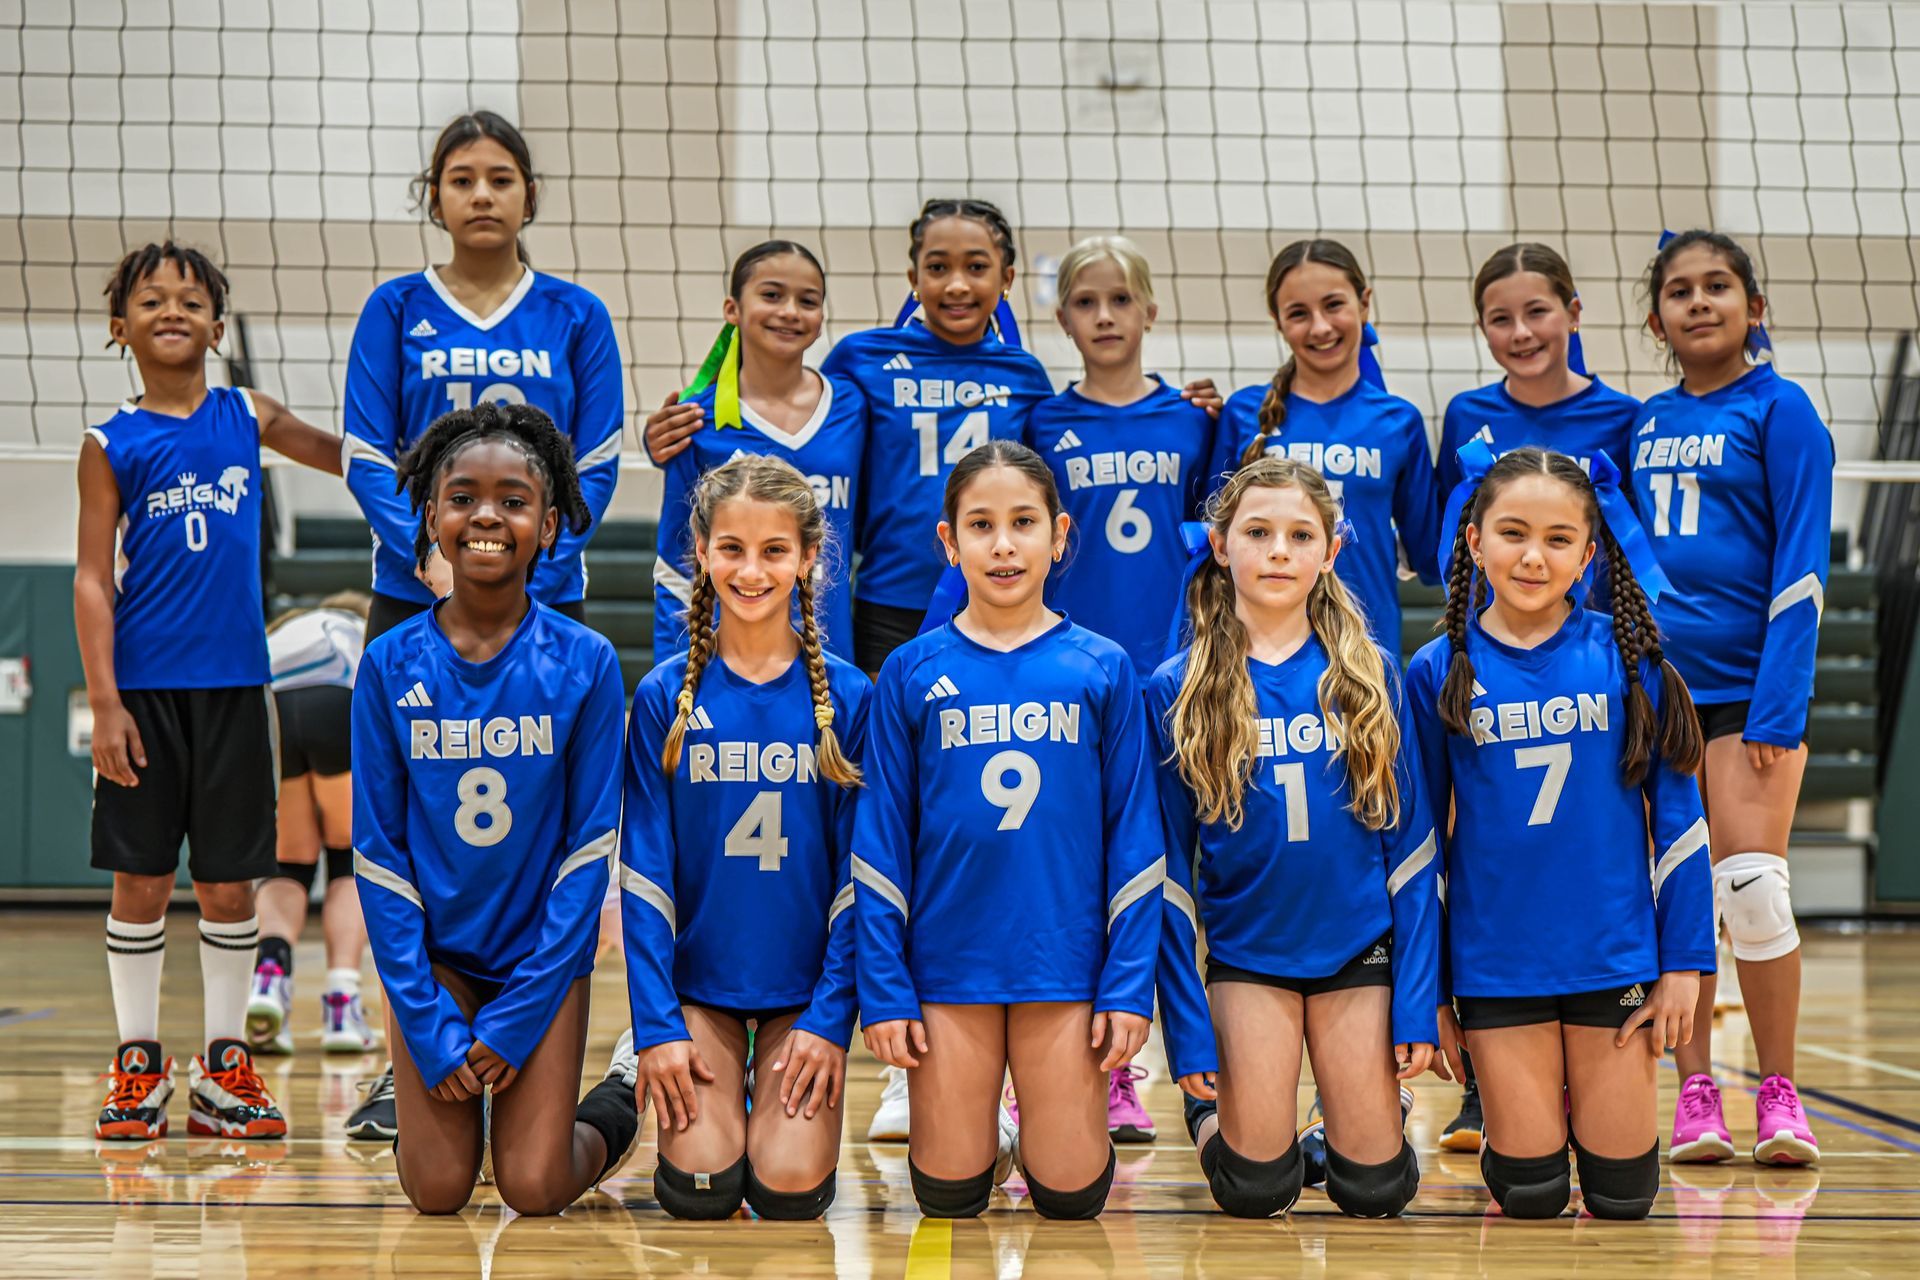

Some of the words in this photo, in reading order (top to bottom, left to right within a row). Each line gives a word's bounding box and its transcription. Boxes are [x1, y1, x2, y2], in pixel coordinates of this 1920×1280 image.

[421, 347, 552, 380] REIGN
[893, 377, 1012, 408] REIGN
[911, 411, 989, 477] 14
[1065, 450, 1180, 491] REIGN
[1633, 434, 1725, 472] REIGN
[1105, 488, 1152, 554] 6
[1650, 472, 1700, 537] 11
[184, 511, 208, 552] 0
[410, 715, 553, 759] REIGN
[939, 701, 1080, 750] REIGN
[1469, 693, 1609, 746] REIGN
[689, 741, 820, 784] REIGN
[1514, 742, 1572, 826] 7
[454, 766, 512, 847] 8
[980, 749, 1041, 831] 9
[1273, 762, 1309, 842] 1
[724, 791, 788, 871] 4
